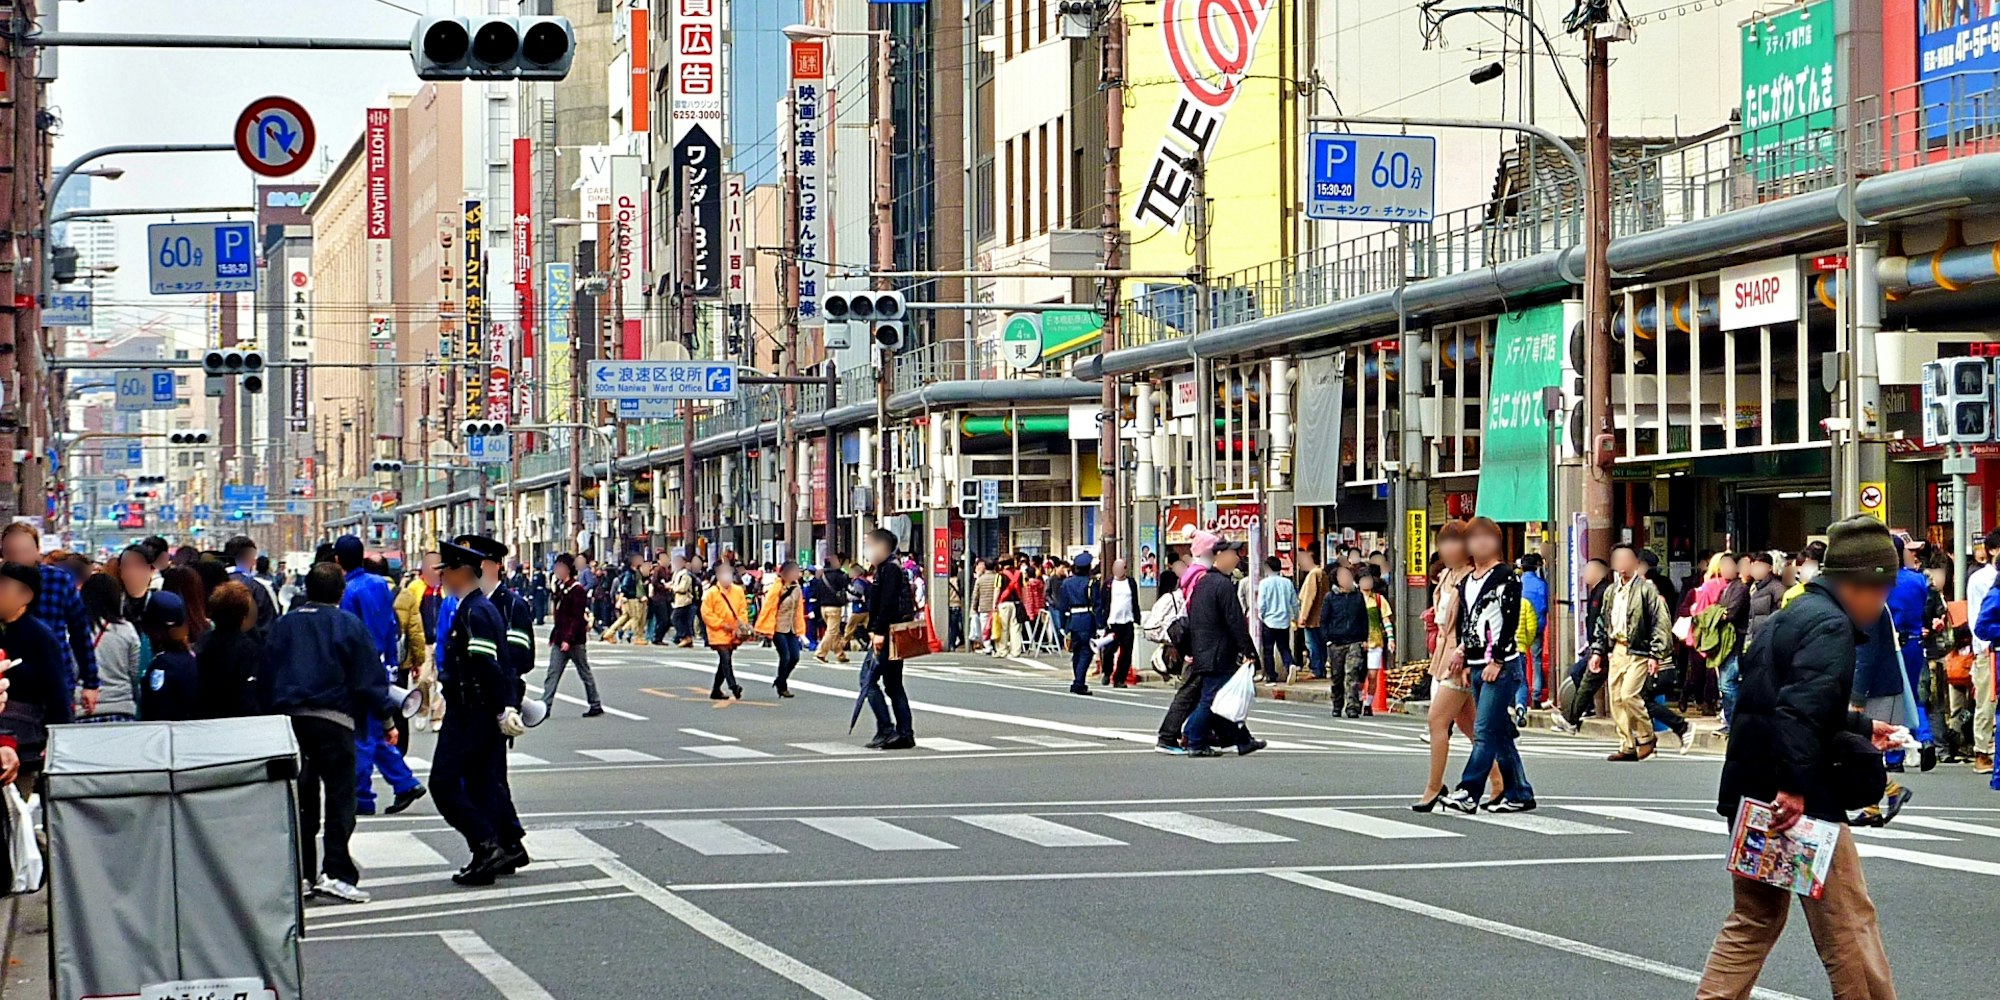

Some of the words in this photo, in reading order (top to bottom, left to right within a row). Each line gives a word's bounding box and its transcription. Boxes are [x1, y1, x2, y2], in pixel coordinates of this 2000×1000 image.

[1764, 24, 1812, 56] メディア専門店
[1746, 62, 1833, 128] たにがわでんき
[799, 85, 816, 166] 映画・音楽
[372, 128, 385, 172] HOTEL
[1326, 144, 1348, 178] P
[1371, 151, 1423, 189] 60分
[372, 177, 387, 236] HILLARYS
[1317, 184, 1352, 197] 15:30-20
[1313, 204, 1429, 218] パーキング・チケット
[160, 236, 203, 267] 60分
[224, 230, 243, 259] P
[800, 176, 816, 316] にっぽんばし道楽
[1735, 276, 1780, 309] SHARP
[1015, 344, 1027, 360] 東
[1504, 334, 1557, 366] メディア専門店
[595, 383, 615, 393] 500m
[618, 383, 647, 393] Naniwa
[653, 383, 674, 393] Ward
[679, 383, 703, 393] Office
[618, 366, 703, 383] 浪速区役所
[488, 378, 508, 420] 王将
